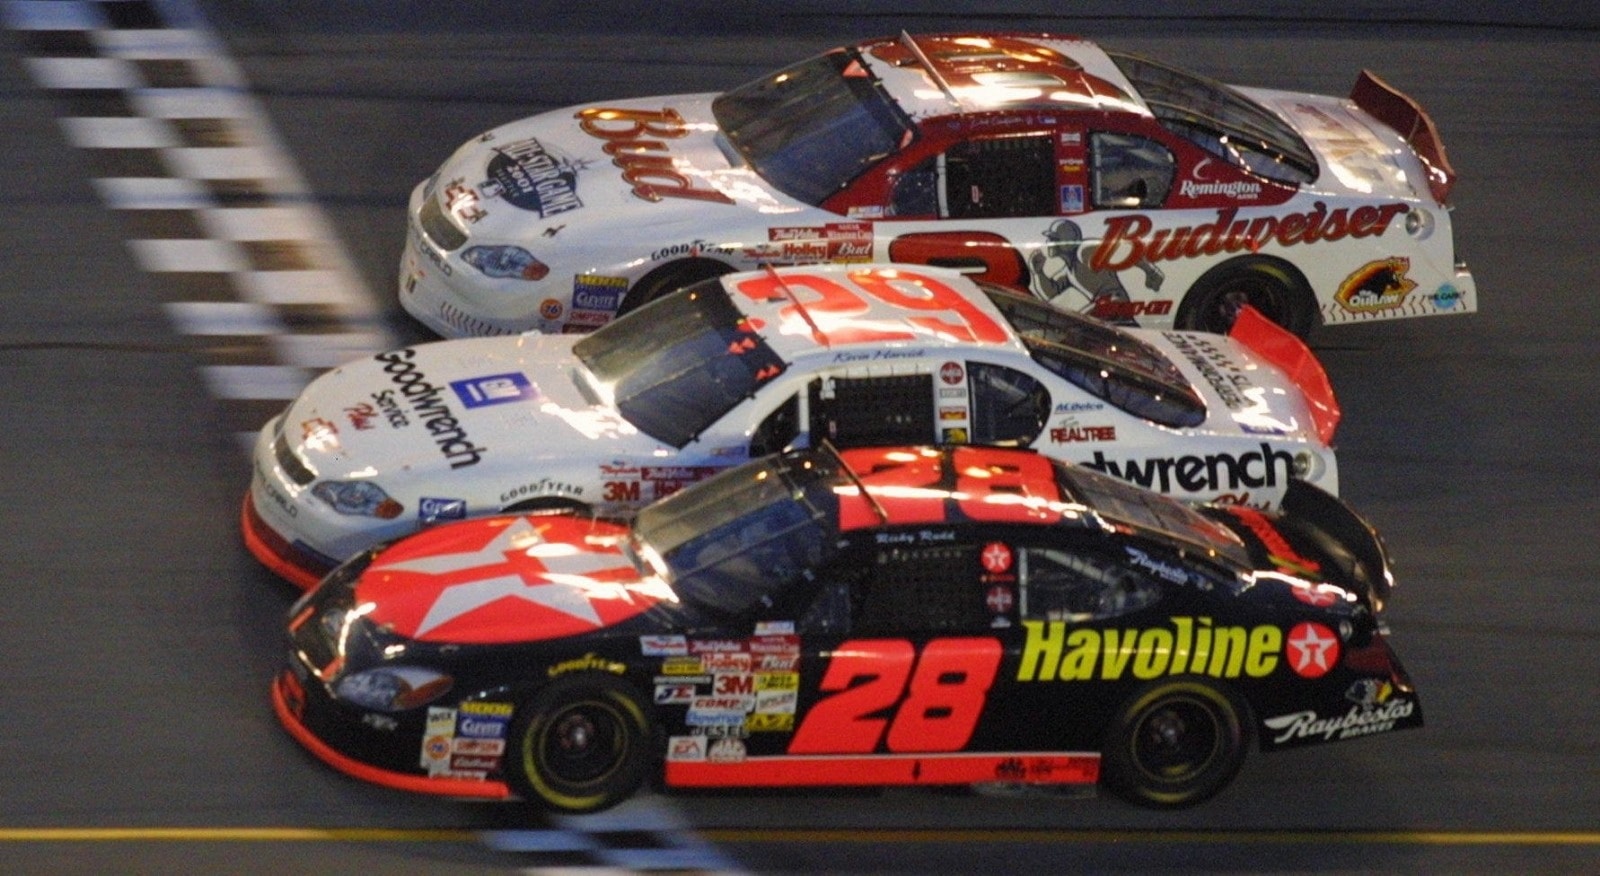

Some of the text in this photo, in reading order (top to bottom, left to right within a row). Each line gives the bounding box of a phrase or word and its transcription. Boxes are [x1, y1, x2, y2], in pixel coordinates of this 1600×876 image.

[573, 107, 737, 206] Bud
[506, 165, 534, 193] 2001
[1179, 178, 1262, 198] Remington
[837, 242, 872, 257] Bud
[1088, 201, 1410, 272] Budweiser
[736, 270, 1009, 346] 29
[371, 389, 410, 430] Service
[374, 350, 488, 470] Goodwrench
[1051, 426, 1117, 446] REALTREE
[500, 478, 583, 503] GOODYEAR
[603, 481, 640, 502] 3M
[838, 446, 1062, 532] 28
[1017, 617, 1282, 680] Havoline
[716, 675, 754, 695] 3M
[787, 637, 1005, 754] 28
[1264, 699, 1414, 743] Raybestos
